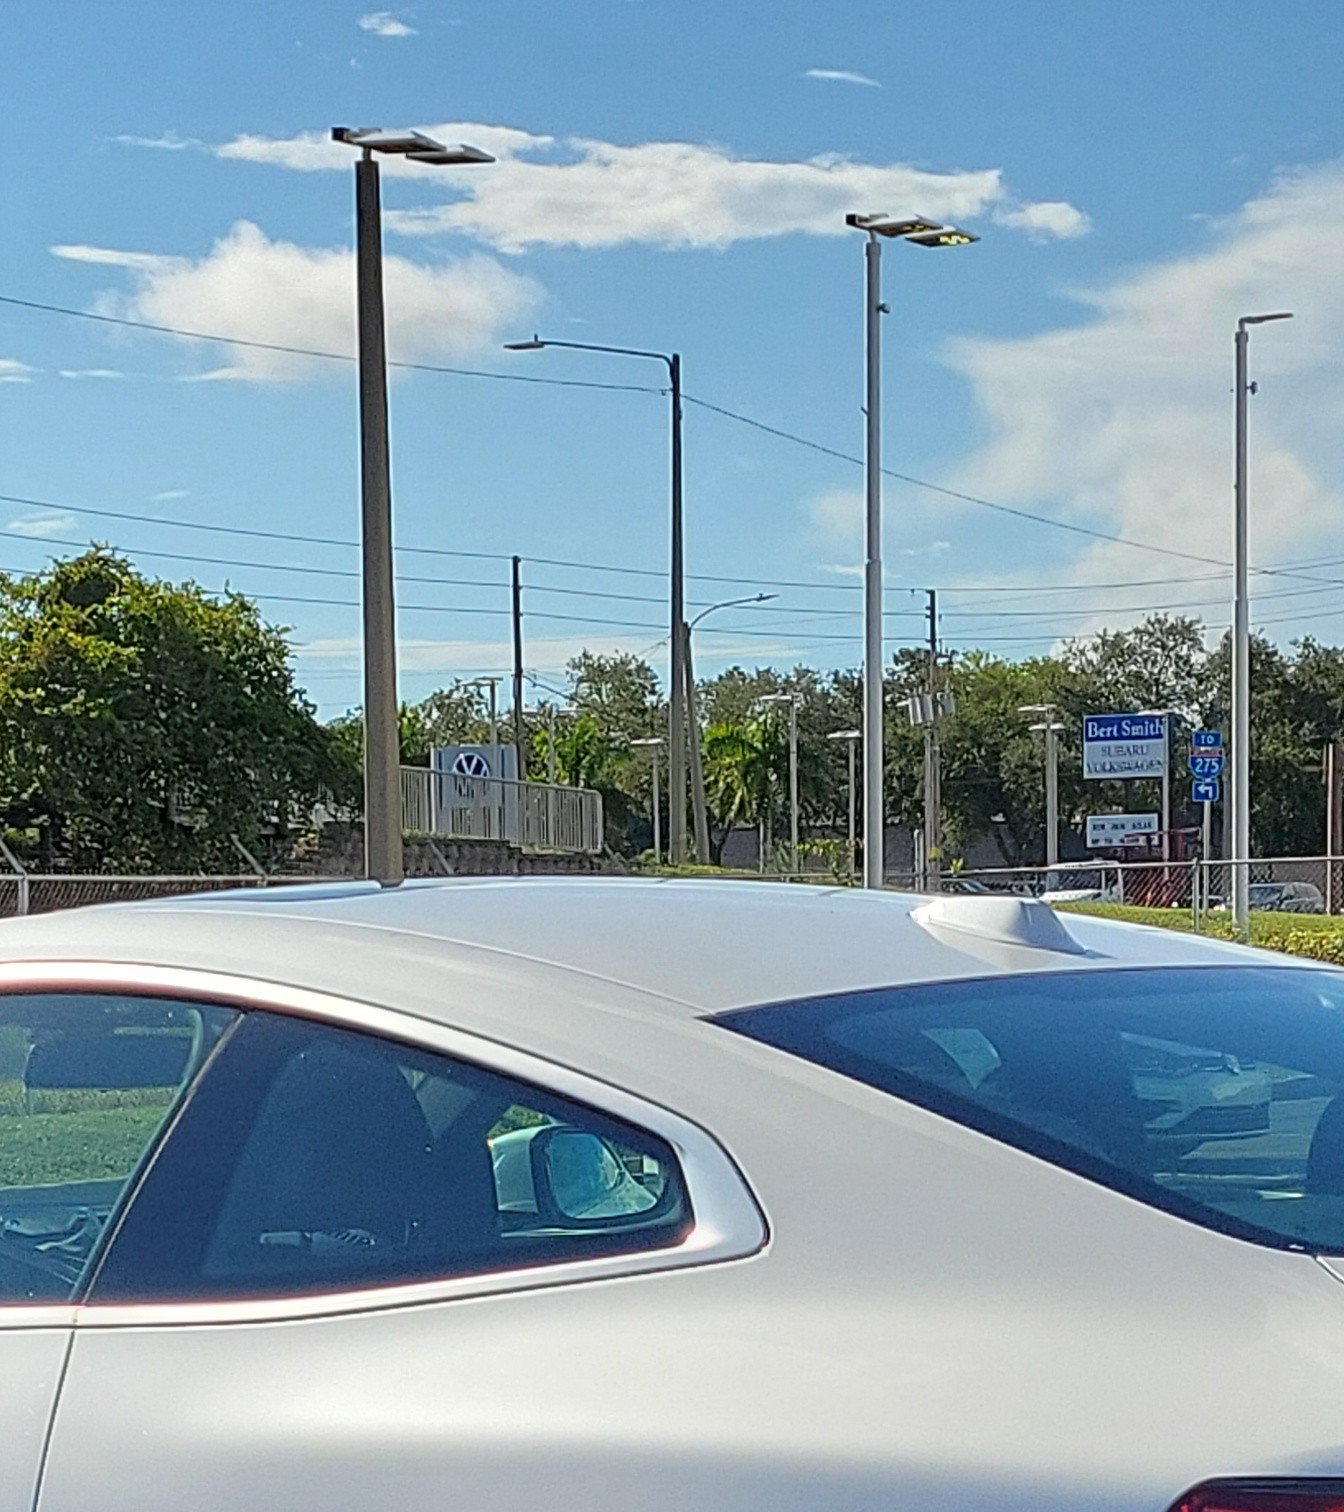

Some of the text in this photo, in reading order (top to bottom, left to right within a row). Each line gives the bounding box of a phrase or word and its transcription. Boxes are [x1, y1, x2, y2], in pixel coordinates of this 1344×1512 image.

[1087, 719, 1164, 738] Bert Smith
[1195, 758, 1220, 774] 275
